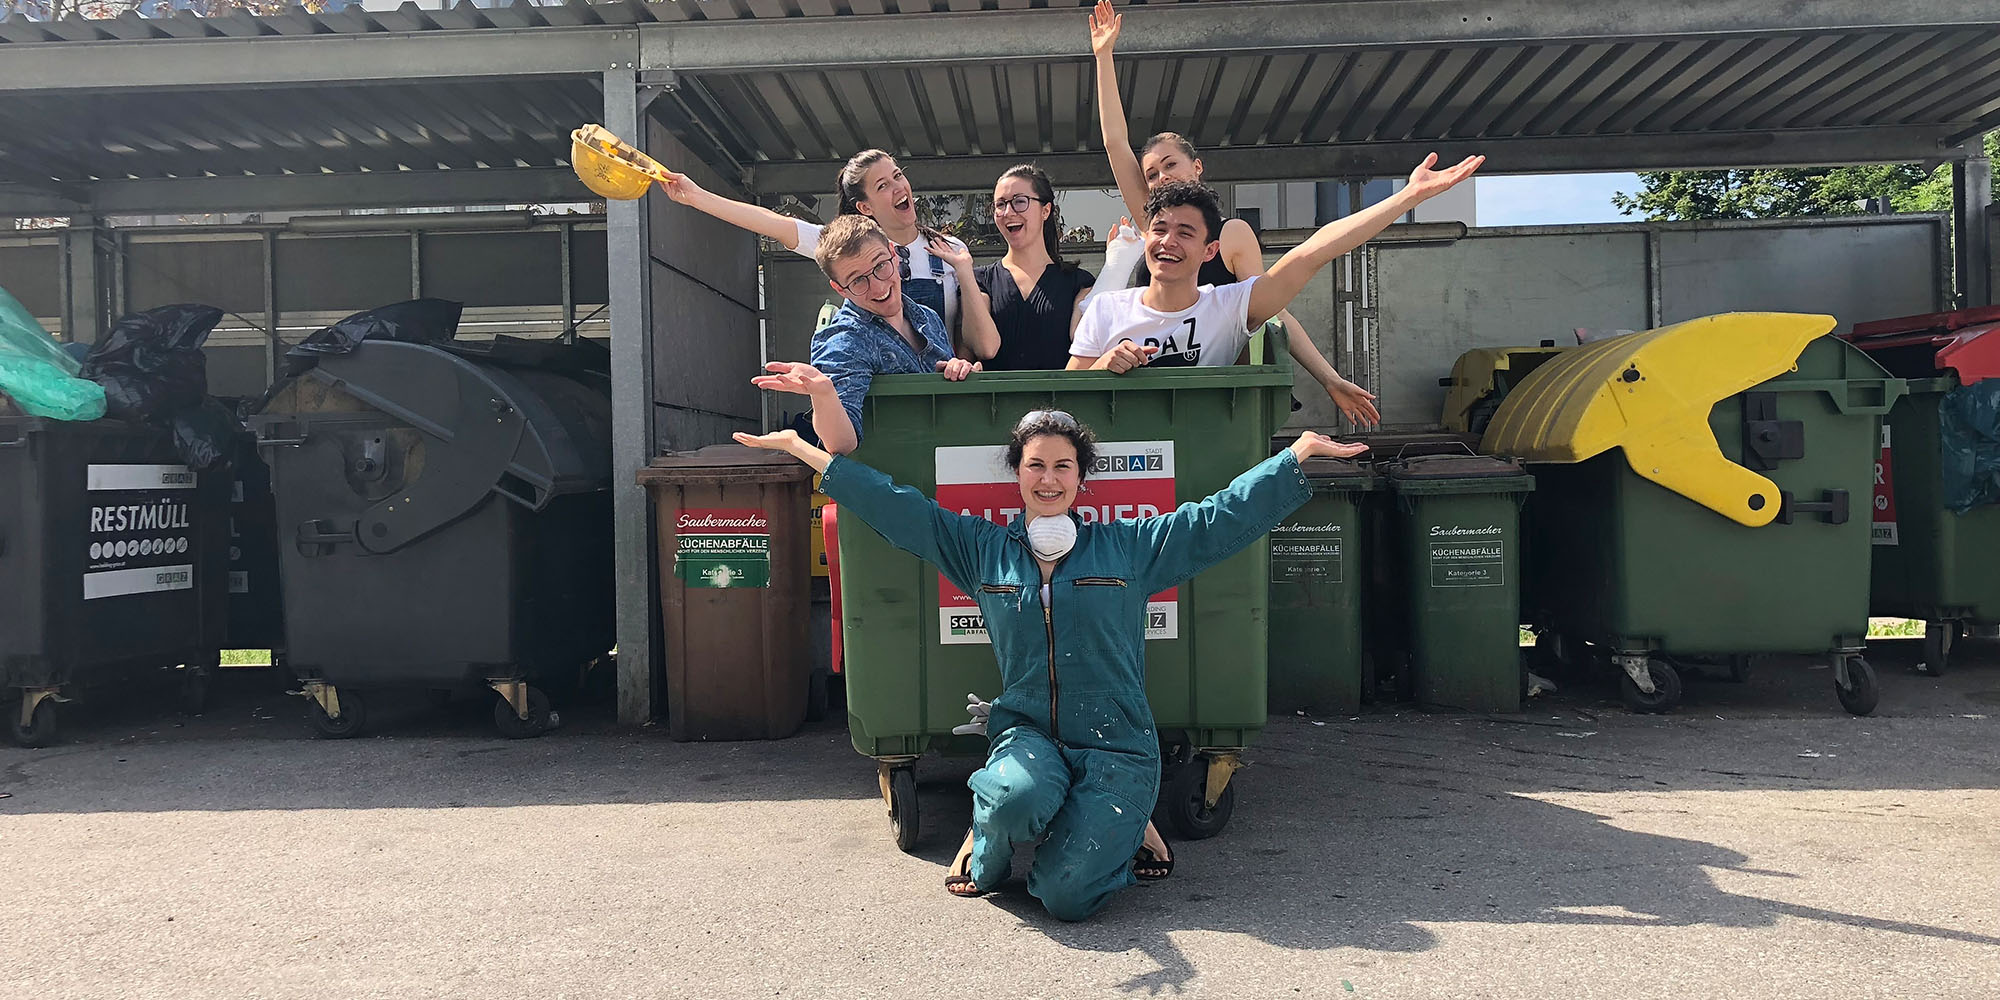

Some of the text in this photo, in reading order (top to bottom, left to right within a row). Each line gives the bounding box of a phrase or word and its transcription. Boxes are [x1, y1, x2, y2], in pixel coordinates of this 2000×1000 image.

[1118, 317, 1201, 360] RAZ
[1095, 456, 1161, 471] GRAZ
[162, 473, 192, 484] GRAZ
[90, 498, 189, 532] RESTMÜLL
[677, 513, 767, 528] Saubermacher
[1271, 522, 1341, 532] Saubermacher
[1430, 525, 1503, 536] Saubermacher
[1272, 544, 1340, 552] KÜCHENABFÄLLE
[1432, 547, 1501, 556] KÜCHENABFÄLLE
[157, 571, 188, 584] GRAZ
[951, 617, 984, 627] serv
